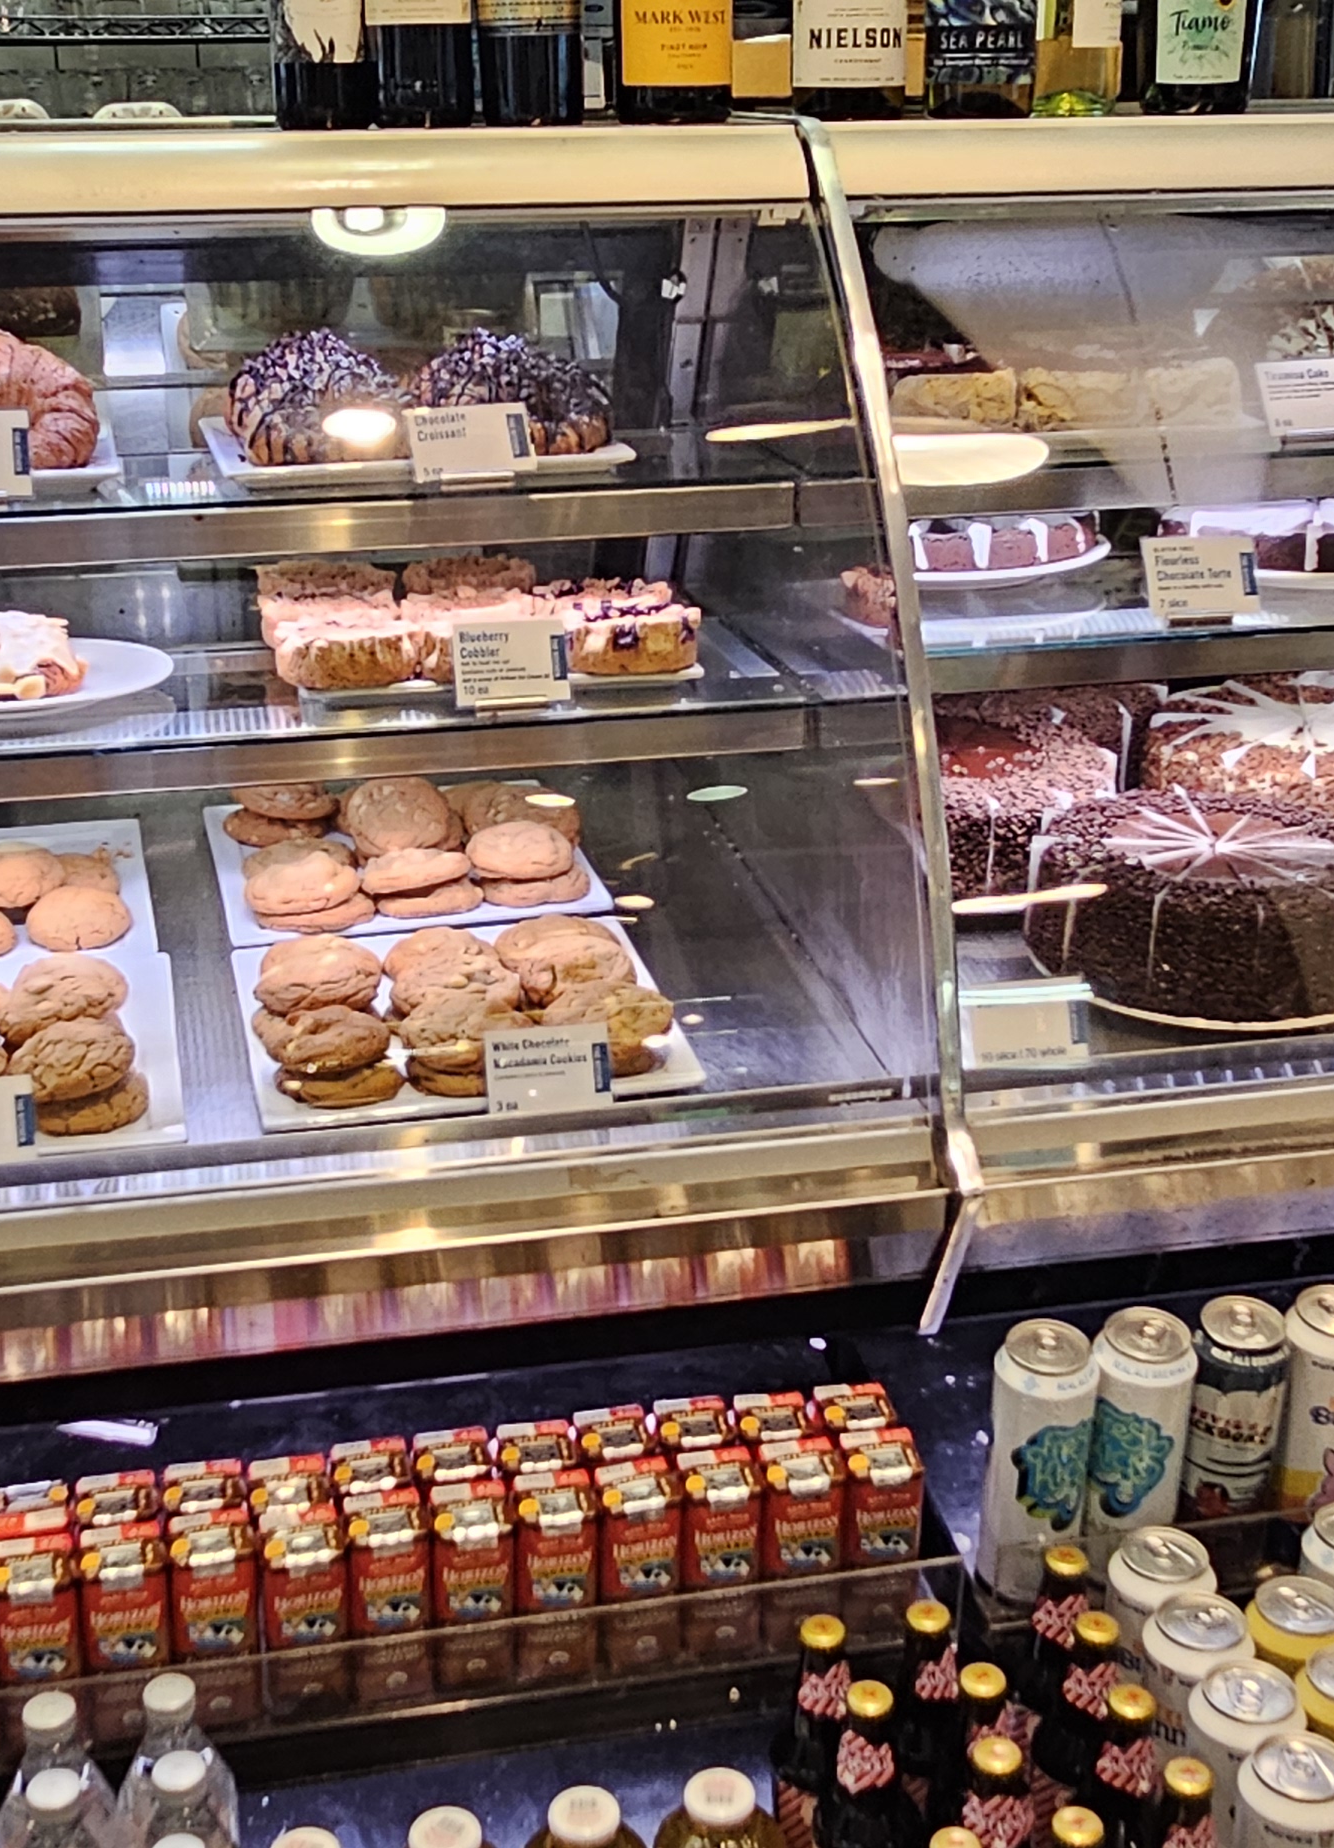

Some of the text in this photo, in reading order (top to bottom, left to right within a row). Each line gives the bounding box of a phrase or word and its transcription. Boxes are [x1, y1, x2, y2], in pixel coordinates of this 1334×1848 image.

[635, 10, 726, 24] MARK WEST
[1169, 9, 1230, 37] Tiamo
[809, 27, 903, 50] NIELSON
[940, 30, 1024, 49] SEA PEARL
[1306, 368, 1330, 379] Cake
[414, 412, 466, 427] Chocolate
[417, 427, 467, 442] Croissant
[1154, 553, 1200, 567] Flourless
[1157, 567, 1232, 582] Chocolate Torte
[1167, 598, 1188, 608] slice
[459, 631, 509, 643] Blueberry
[460, 646, 500, 659] Cobbler
[463, 685, 489, 695] 10 ea
[491, 1037, 570, 1052] White Chocolate
[494, 1052, 587, 1069] Mcadamia Cookies
[995, 1050, 1017, 1061] slice
[1038, 1045, 1066, 1057] whole
[506, 1100, 519, 1110] ea
[856, 1504, 918, 1523] HORIZON
[774, 1514, 839, 1534] HORIZON
[695, 1524, 758, 1545] HORIZON
[612, 1535, 677, 1557] HORIZON
[527, 1547, 593, 1569] HORIZON
[358, 1563, 426, 1592] HORIZON
[443, 1561, 509, 1582] HORIZON
[180, 1587, 250, 1613] HORIZON
[273, 1581, 343, 1612] HORIZON
